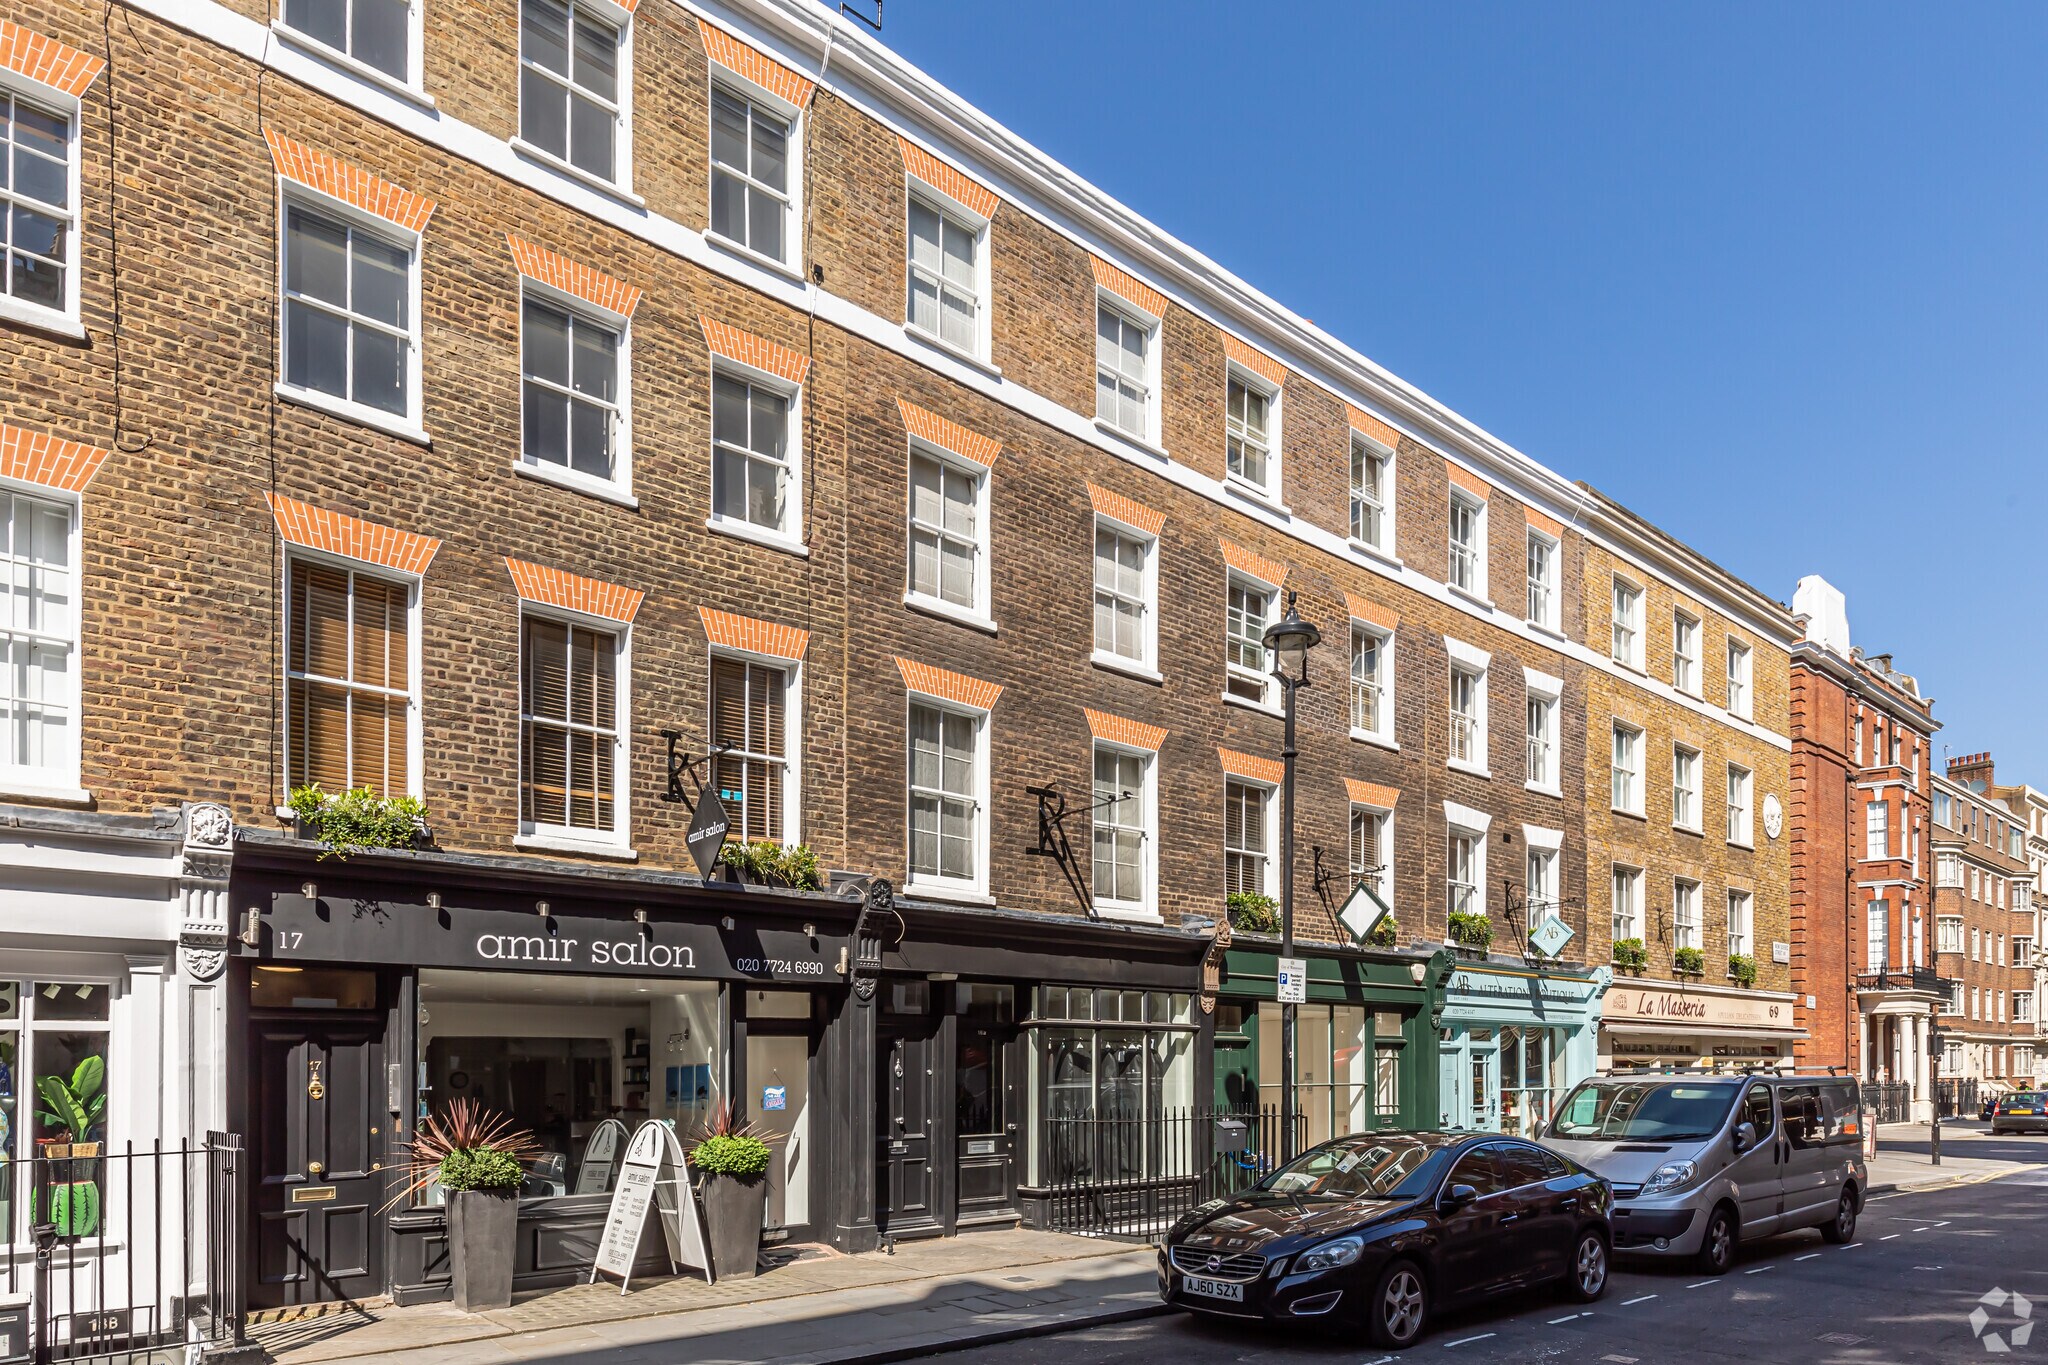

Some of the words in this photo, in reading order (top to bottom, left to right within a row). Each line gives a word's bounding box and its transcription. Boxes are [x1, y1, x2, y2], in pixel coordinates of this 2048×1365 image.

[689, 828, 705, 843] amir
[706, 821, 725, 838] salon
[280, 931, 303, 949] 17
[1543, 926, 1559, 940] AB
[477, 929, 578, 962] amir
[591, 932, 696, 968] salon
[737, 958, 760, 972] 020
[763, 959, 792, 974] 7724
[795, 961, 824, 975] 6990
[1281, 974, 1286, 983] P
[1535, 987, 1575, 1005] BOUTIQUE
[1637, 992, 1654, 1015] La
[1657, 994, 1706, 1018] Masseria
[1769, 1005, 1779, 1018] 69
[309, 1060, 321, 1071] 17
[628, 1172, 638, 1181] amir
[638, 1174, 650, 1183] salon
[1187, 1278, 1213, 1294] AJ60
[1216, 1283, 1238, 1298] SZX
